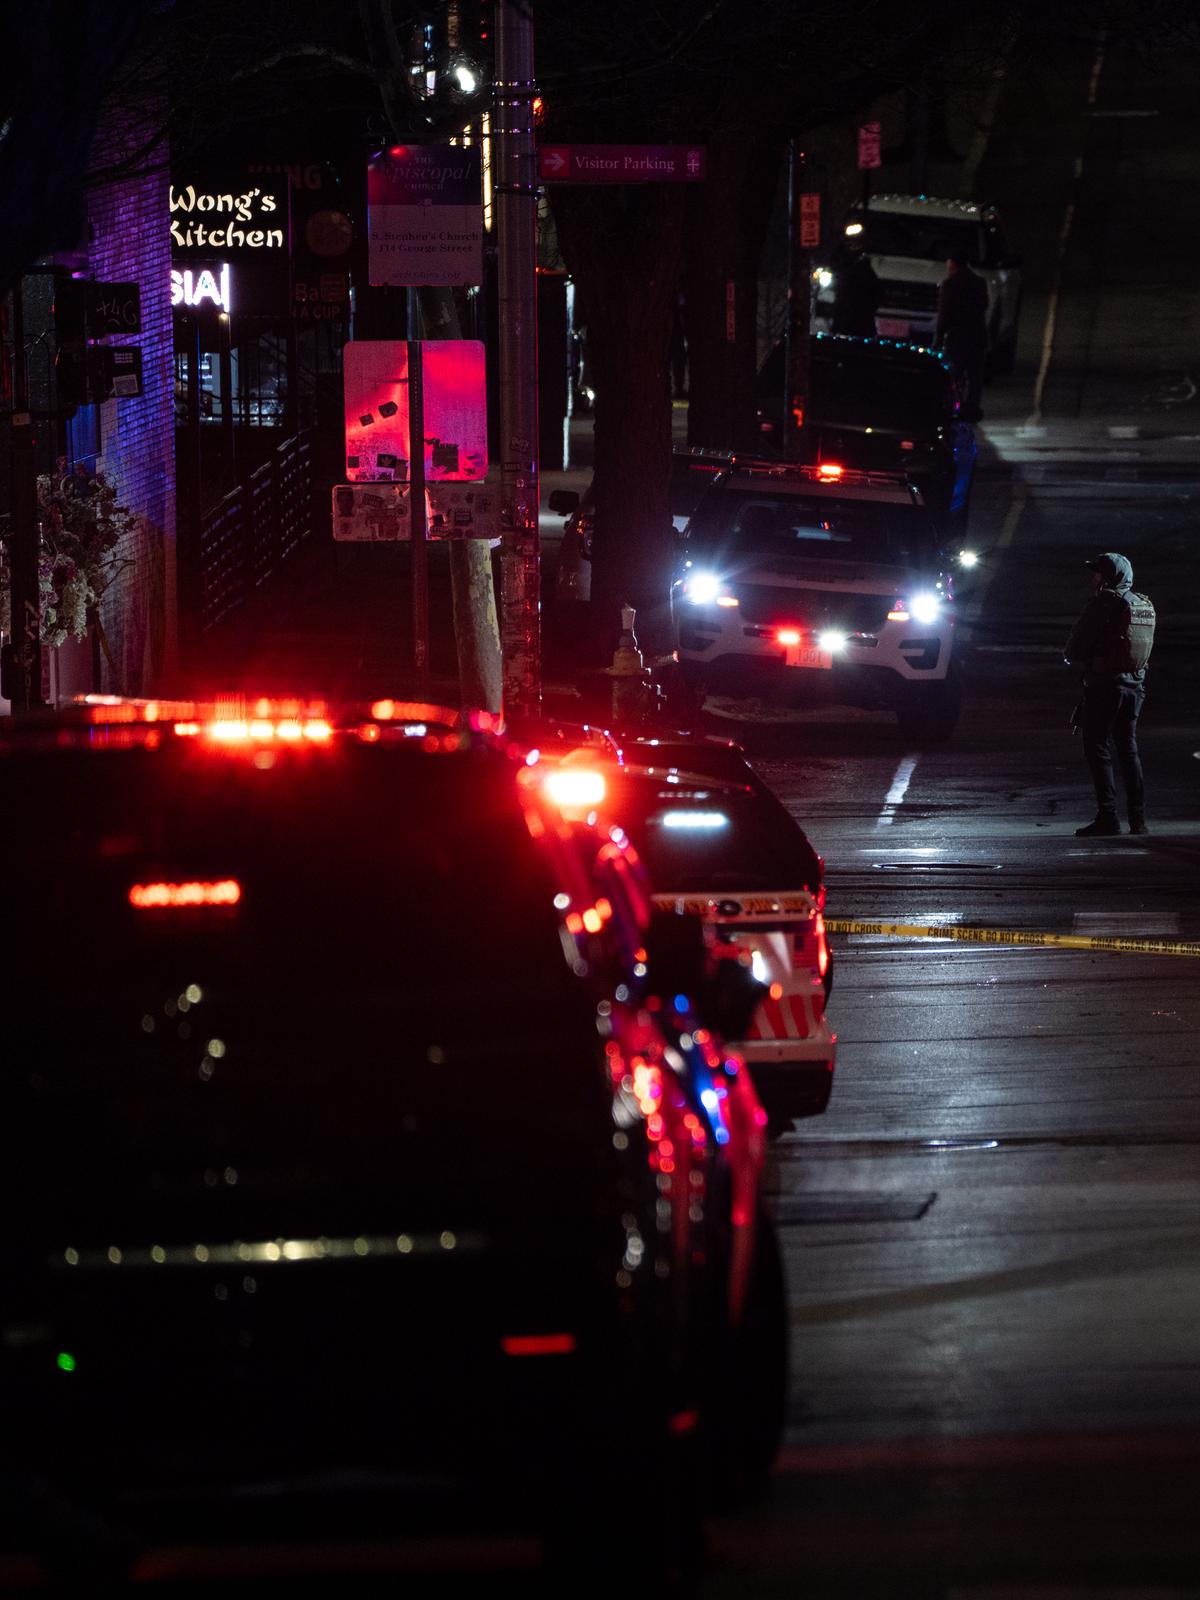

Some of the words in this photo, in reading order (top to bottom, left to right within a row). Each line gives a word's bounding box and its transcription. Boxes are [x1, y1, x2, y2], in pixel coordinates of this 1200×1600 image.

[575, 156, 619, 169] Visitor
[624, 156, 676, 172] Parking
[169, 185, 277, 221] Wong's
[439, 231, 479, 241] Church
[399, 243, 436, 254] George
[440, 243, 473, 253] Street
[836, 921, 852, 933] NOT
[854, 923, 882, 934] CROSS
[927, 927, 955, 939] CRIME
[957, 928, 985, 941] SCENE
[986, 931, 998, 941] DO
[1000, 931, 1016, 943] NOT
[1018, 933, 1046, 945] CROSS
